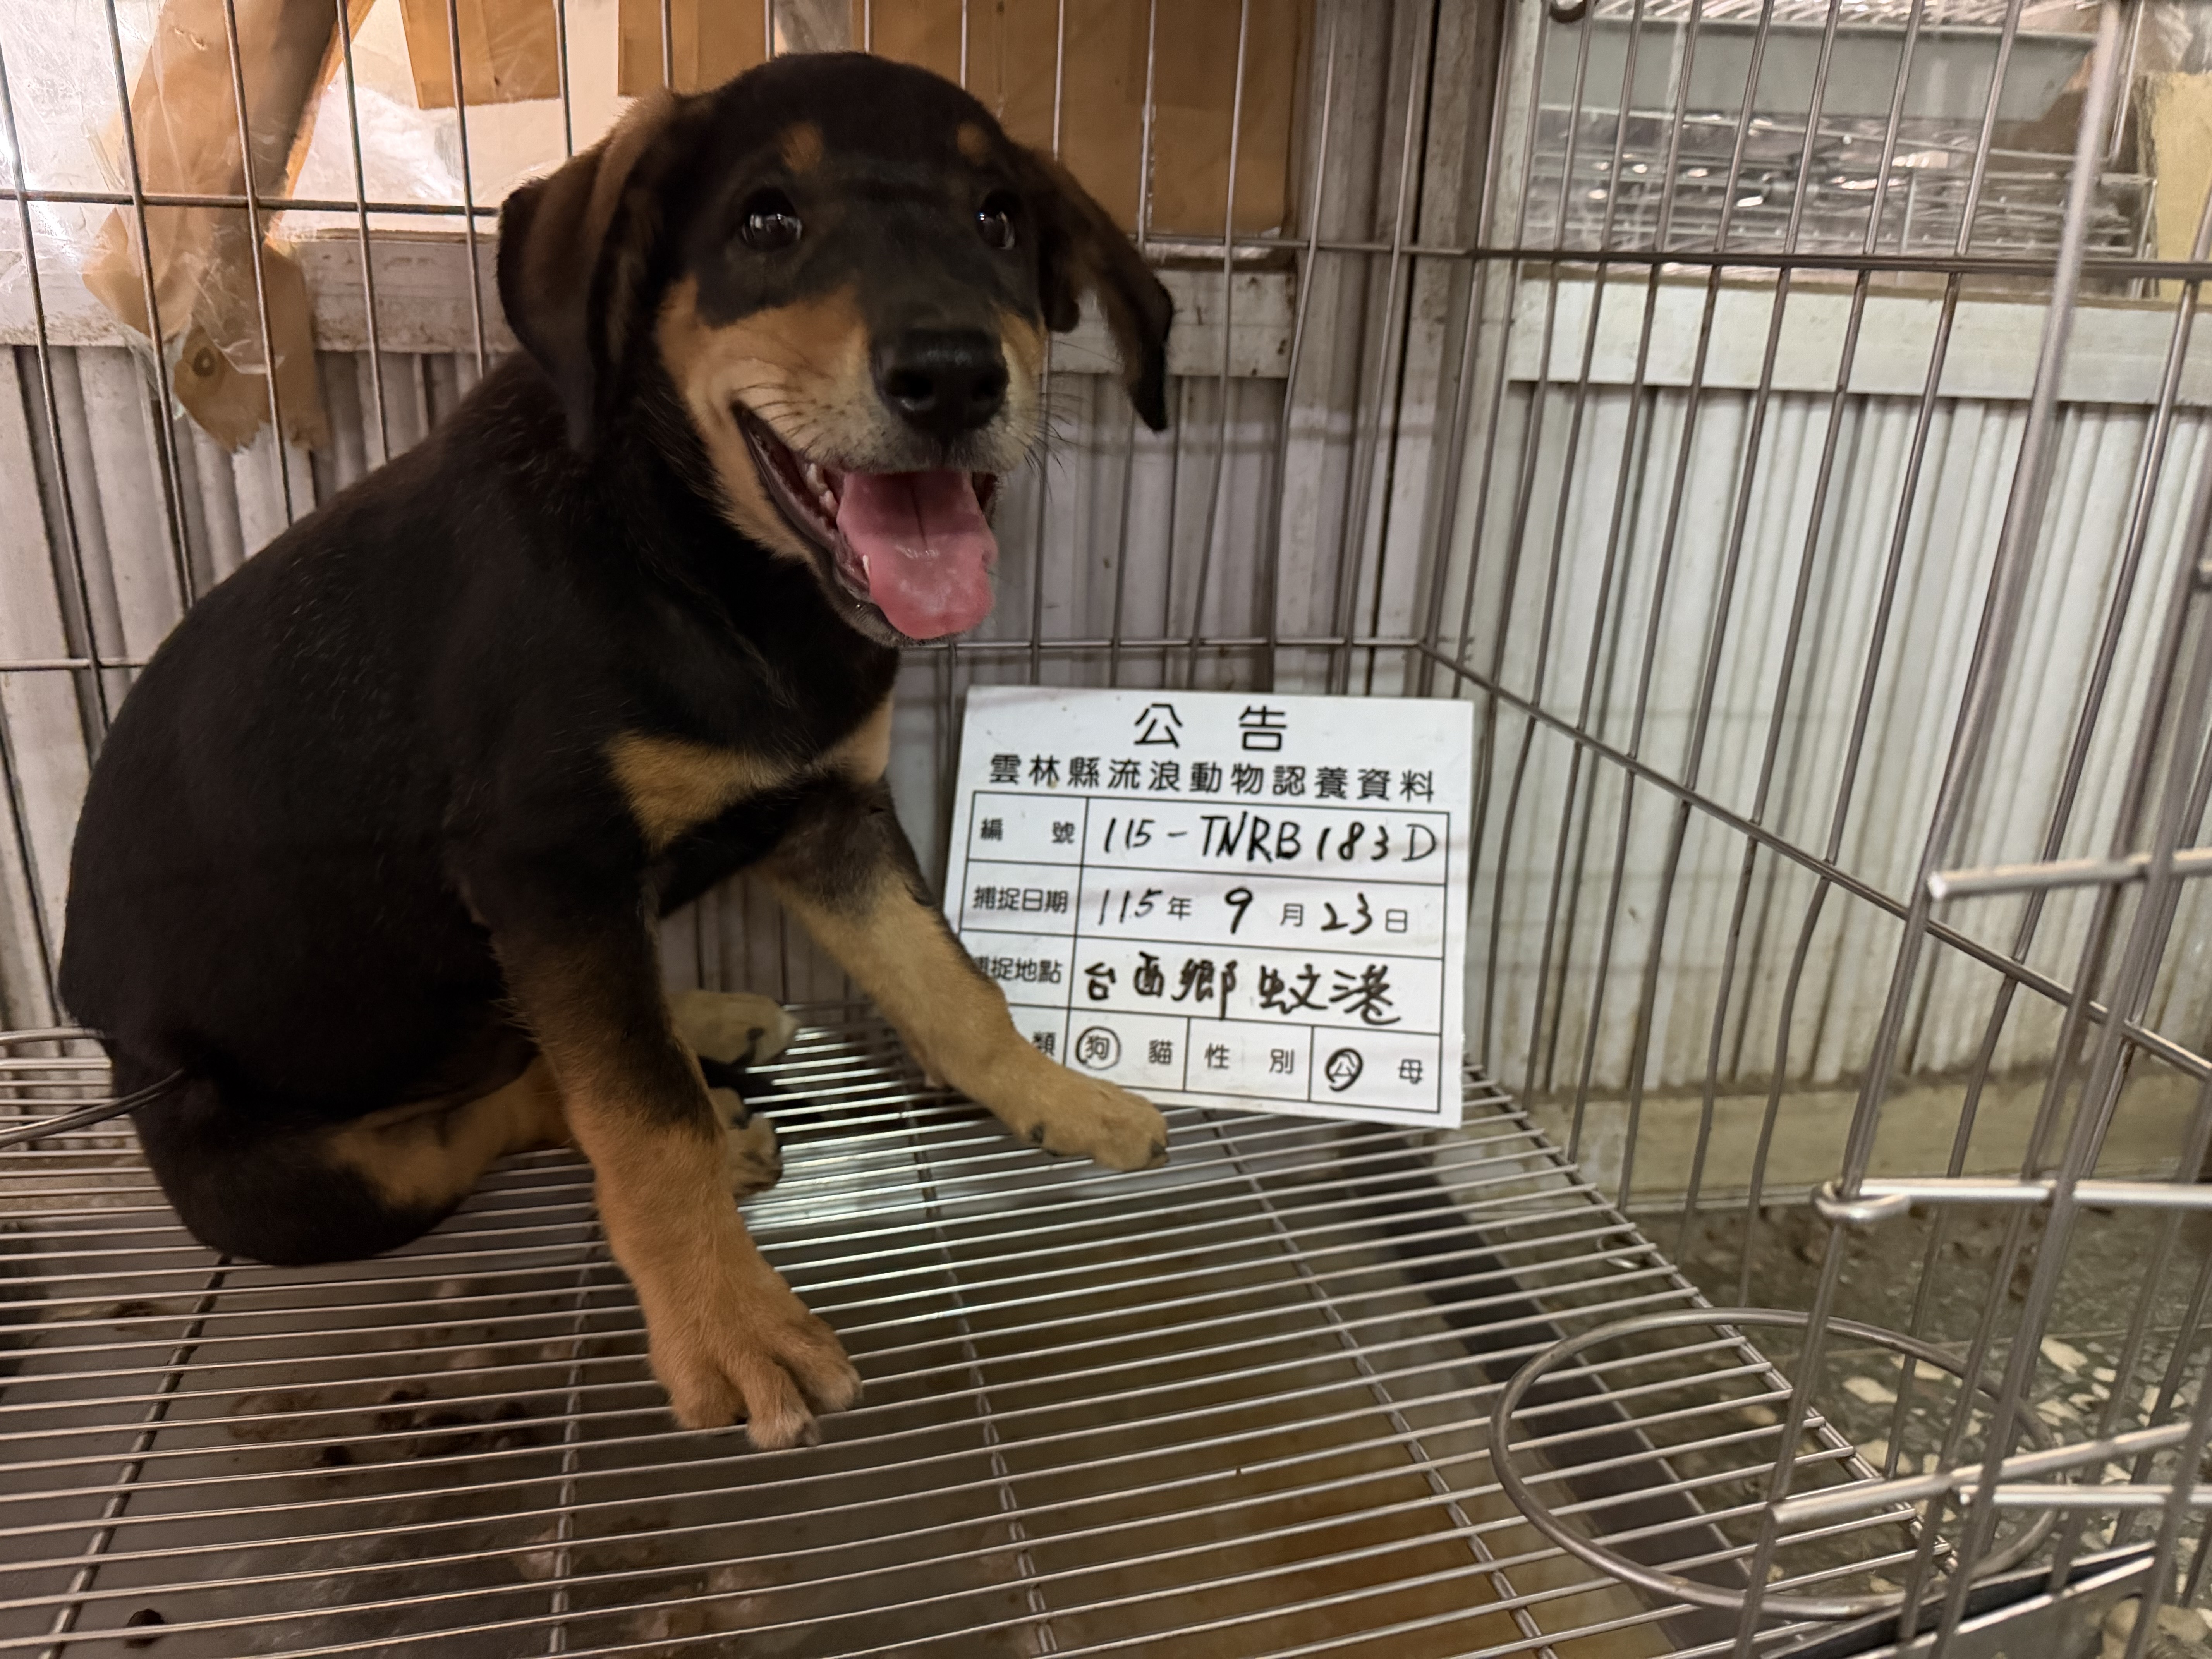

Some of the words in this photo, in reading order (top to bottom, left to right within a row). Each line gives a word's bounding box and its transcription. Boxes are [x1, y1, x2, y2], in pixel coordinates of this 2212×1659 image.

[1133, 702, 1288, 752] 公告
[989, 753, 1435, 803] 雲林縣流浪動物認養資料
[980, 818, 1075, 844] 編號
[972, 886, 1069, 914] 捕捉日期
[1084, 1035, 1110, 1060] 狗
[1148, 1039, 1173, 1065] 貓
[1204, 1042, 1295, 1075] 性別
[1398, 1058, 1424, 1084] 母
